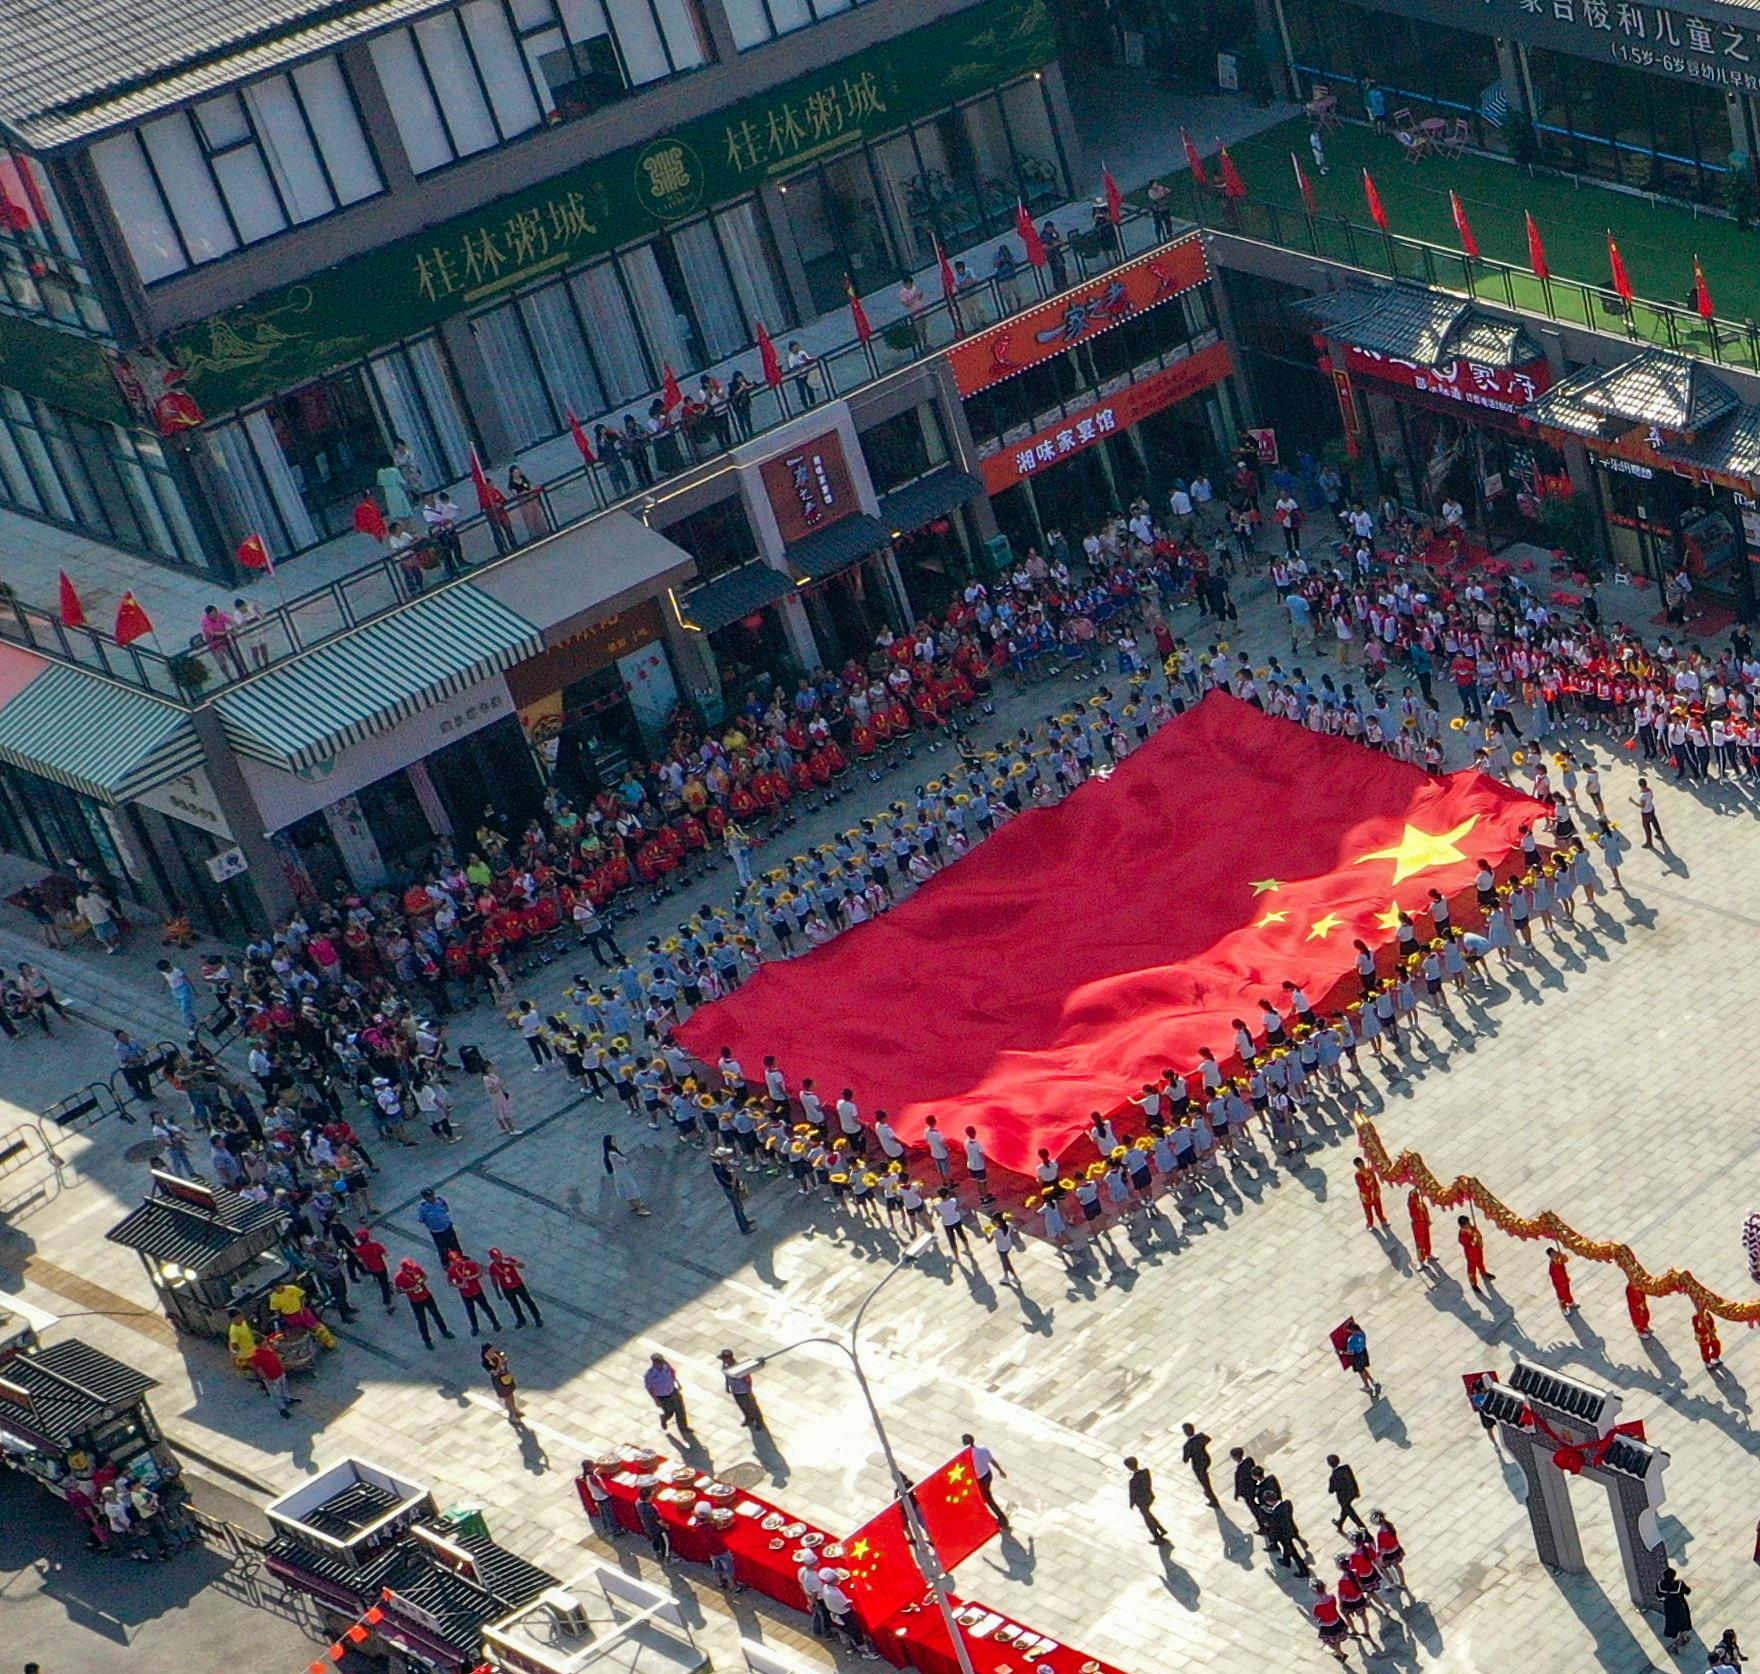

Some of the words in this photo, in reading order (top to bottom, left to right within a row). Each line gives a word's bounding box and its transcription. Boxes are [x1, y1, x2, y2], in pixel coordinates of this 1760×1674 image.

[725, 71, 888, 173] 桂林粥城
[413, 192, 597, 302] 桂林粥城
[1016, 408, 1118, 474] 湘味家宴馆
